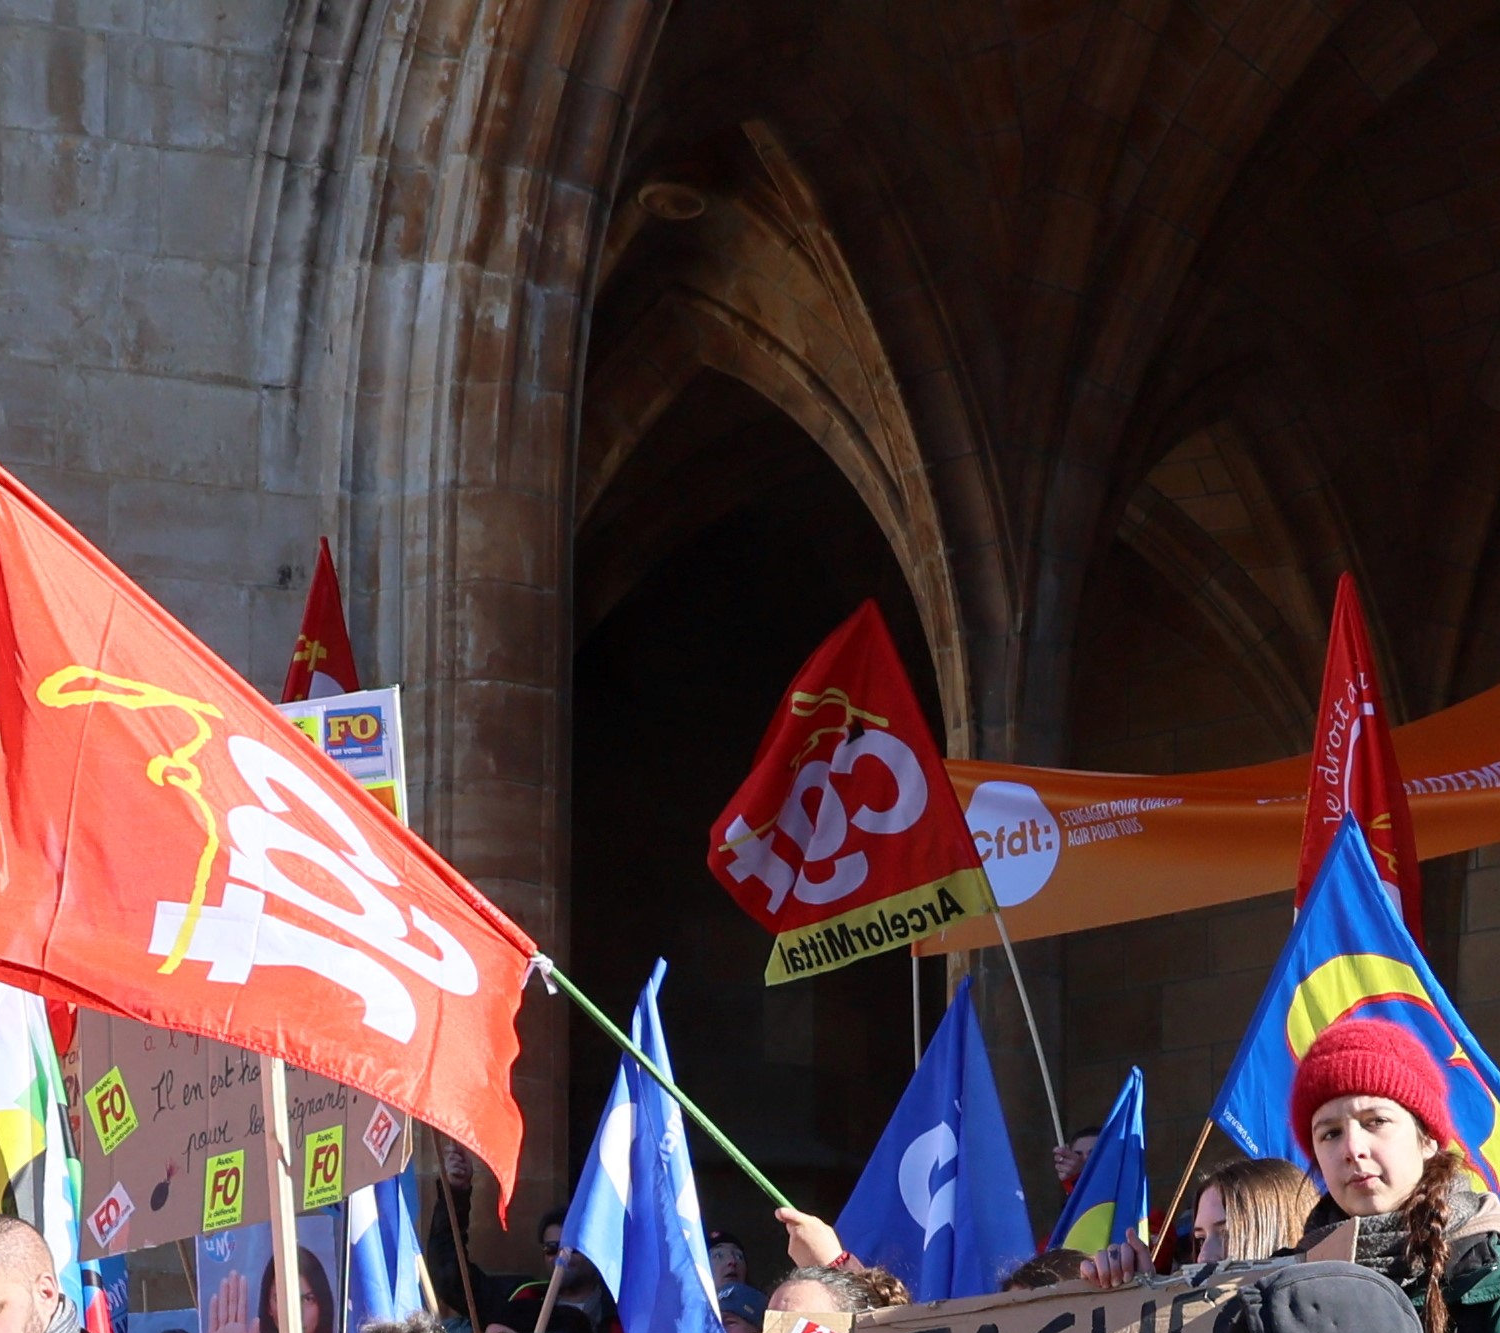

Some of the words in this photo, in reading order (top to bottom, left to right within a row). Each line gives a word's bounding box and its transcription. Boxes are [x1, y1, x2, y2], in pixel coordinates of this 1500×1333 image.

[326, 714, 381, 747] FO
[1317, 697, 1350, 786] droit
[1059, 803, 1109, 828] S'ENGAGER
[1110, 798, 1139, 815] POUR
[1067, 828, 1090, 848] AGIR
[1092, 823, 1118, 842] POUR
[1119, 816, 1144, 836] TOUS
[183, 1082, 205, 1107] en
[209, 1055, 235, 1095] est
[96, 1083, 127, 1135] FO
[182, 1122, 234, 1174] pour
[309, 1142, 340, 1189] FO
[210, 1165, 241, 1210] FO
